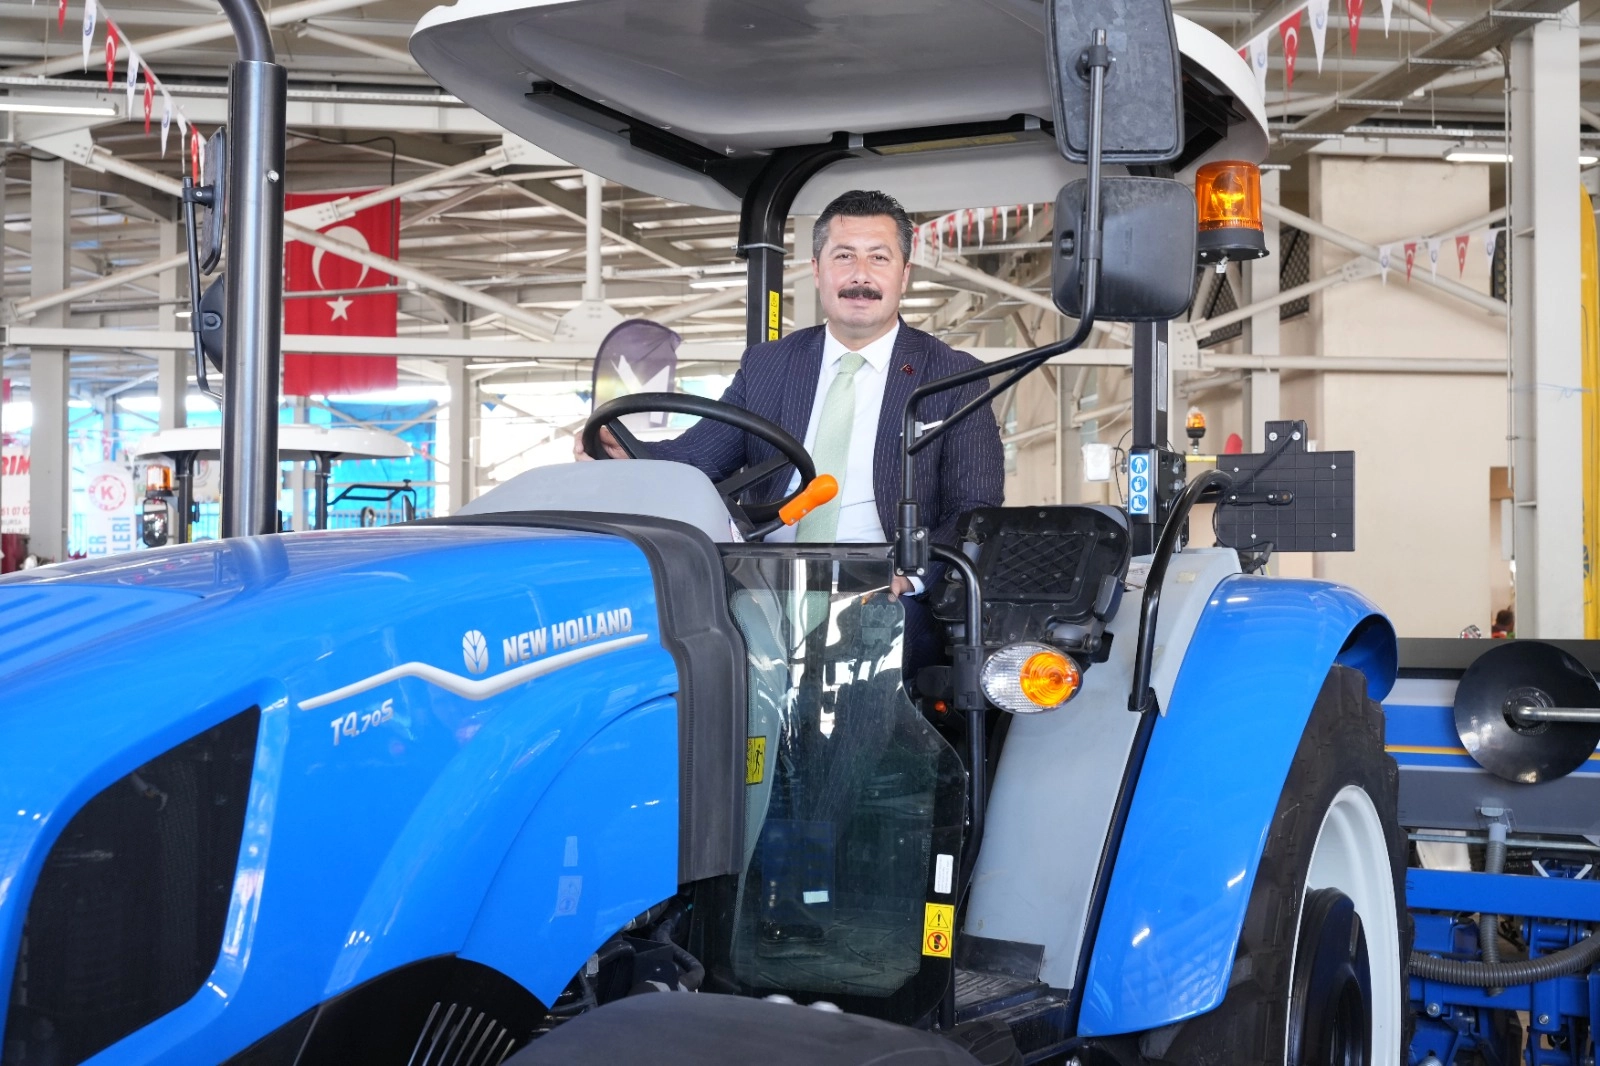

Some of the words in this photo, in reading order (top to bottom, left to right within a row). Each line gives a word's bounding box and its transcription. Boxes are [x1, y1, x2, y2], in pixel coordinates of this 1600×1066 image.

[101, 486, 114, 500] K
[502, 627, 547, 666] NEW
[551, 607, 632, 650] HOLLAND
[331, 698, 394, 746] T4.70S
